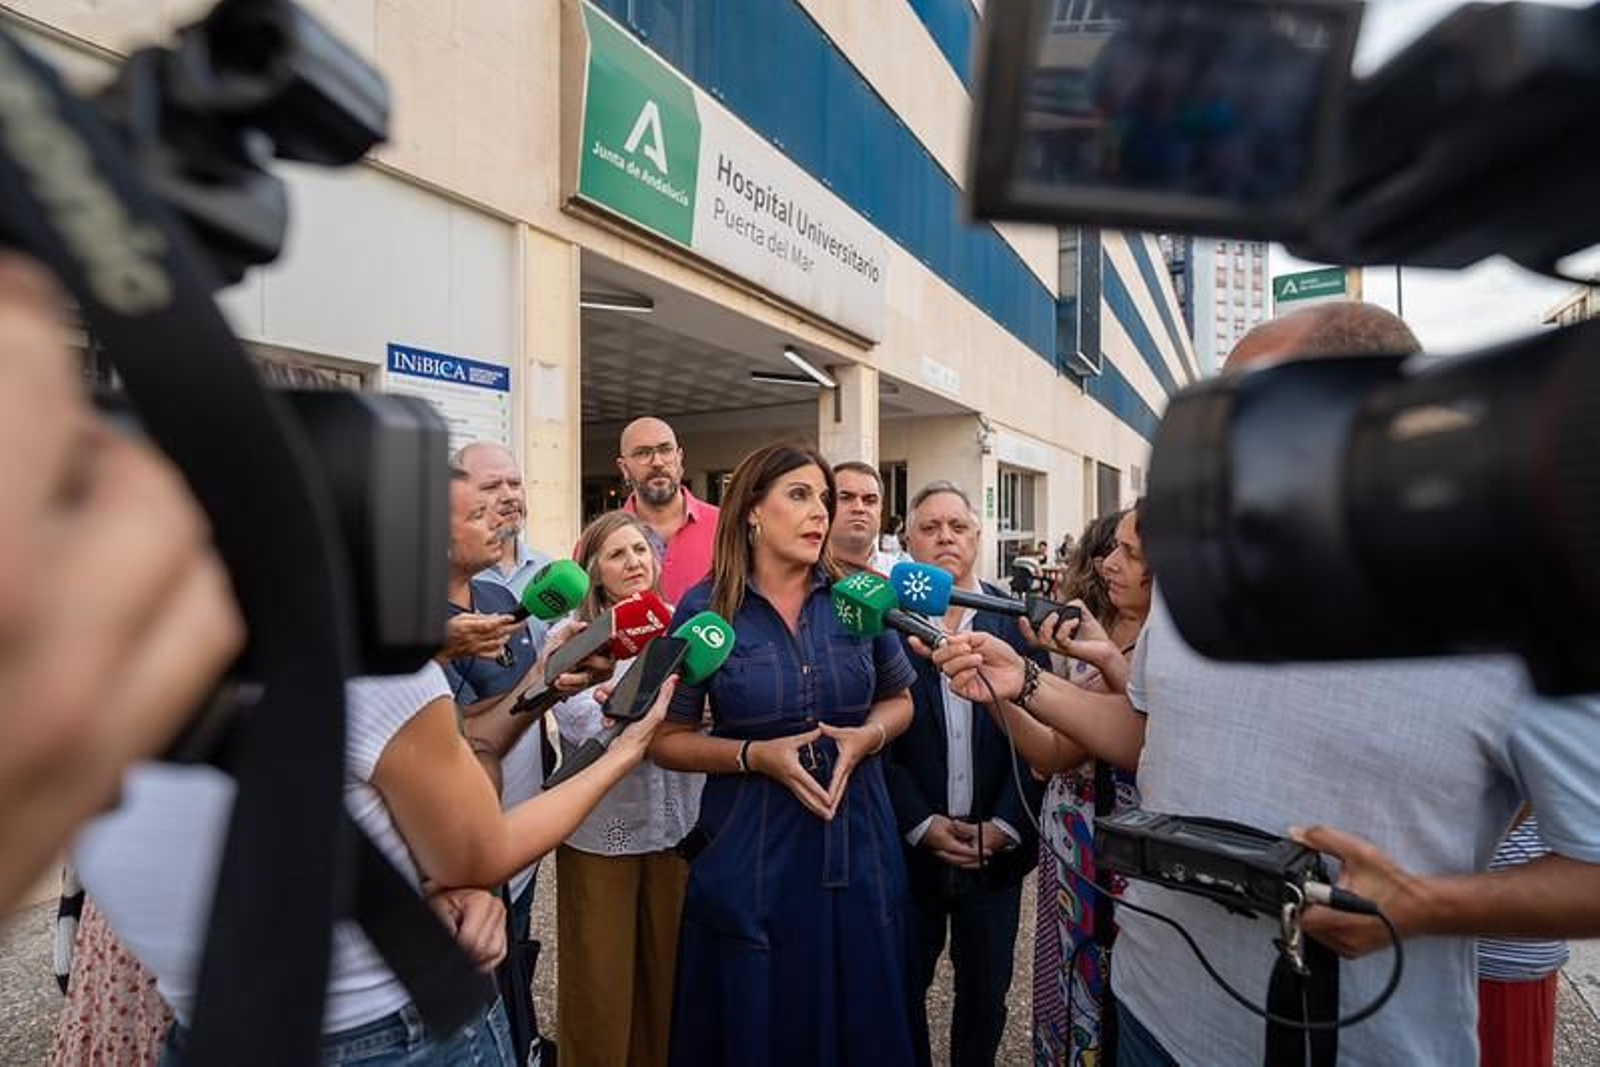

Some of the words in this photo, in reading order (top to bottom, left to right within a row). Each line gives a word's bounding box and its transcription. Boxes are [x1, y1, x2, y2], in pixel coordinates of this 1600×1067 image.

[592, 141, 625, 170] Junta
[626, 161, 641, 178] de
[714, 197, 765, 247] Puerta
[767, 231, 789, 260] del
[792, 244, 815, 273] Mar
[717, 153, 793, 228] Hospital
[796, 207, 881, 283] Universitario
[393, 351, 467, 381] INiBICA
